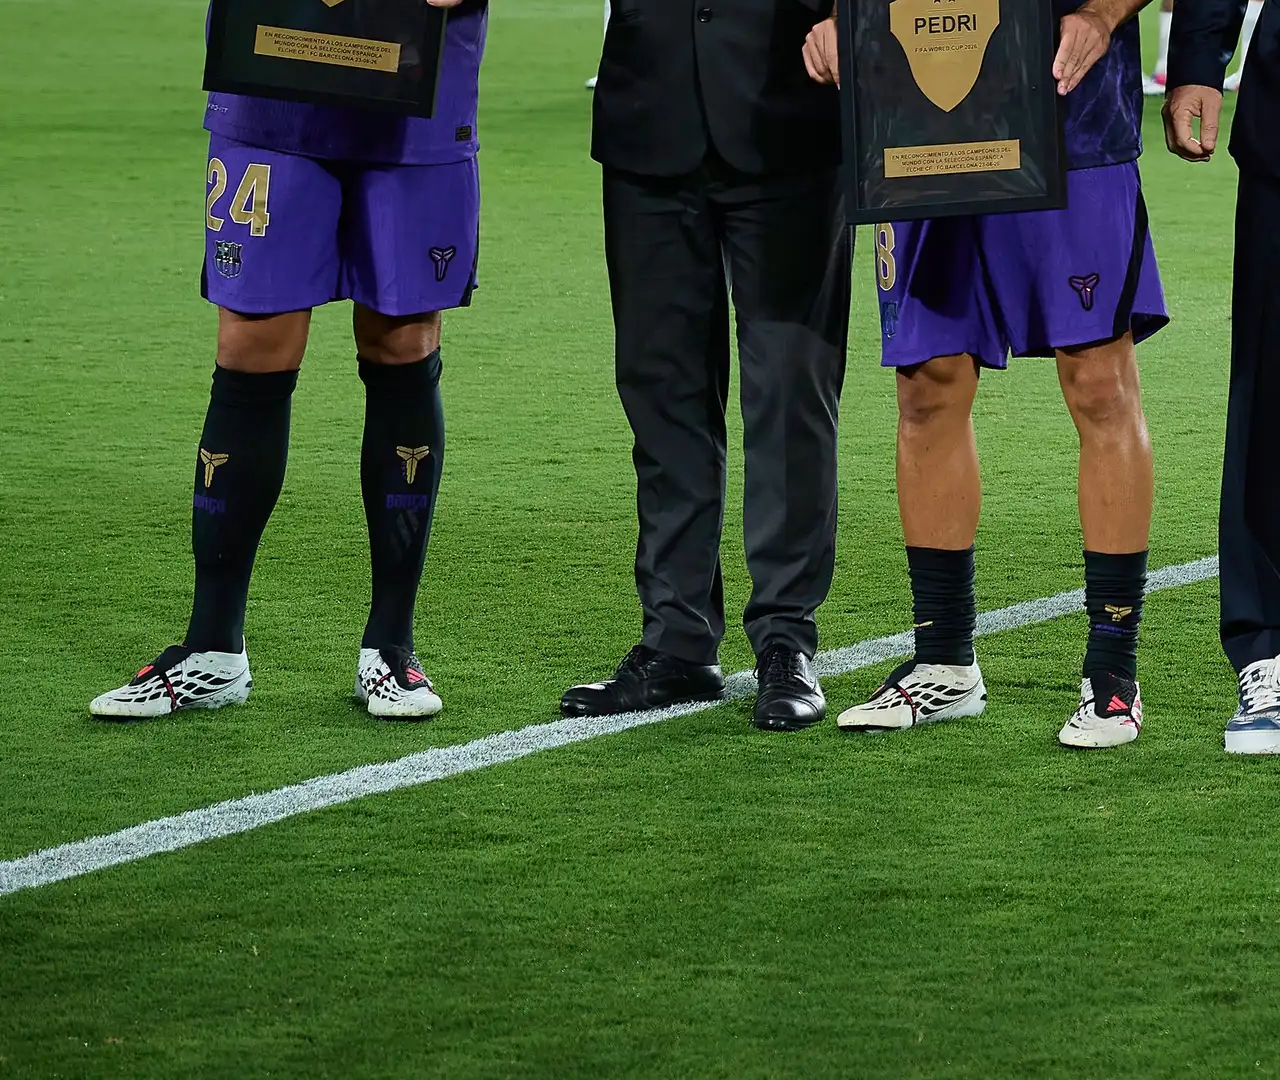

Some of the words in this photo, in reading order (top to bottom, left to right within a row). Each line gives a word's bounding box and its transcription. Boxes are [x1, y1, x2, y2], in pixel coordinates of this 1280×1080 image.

[915, 14, 976, 34] PEDRI
[206, 157, 271, 237] 24
[875, 222, 896, 291] 8
